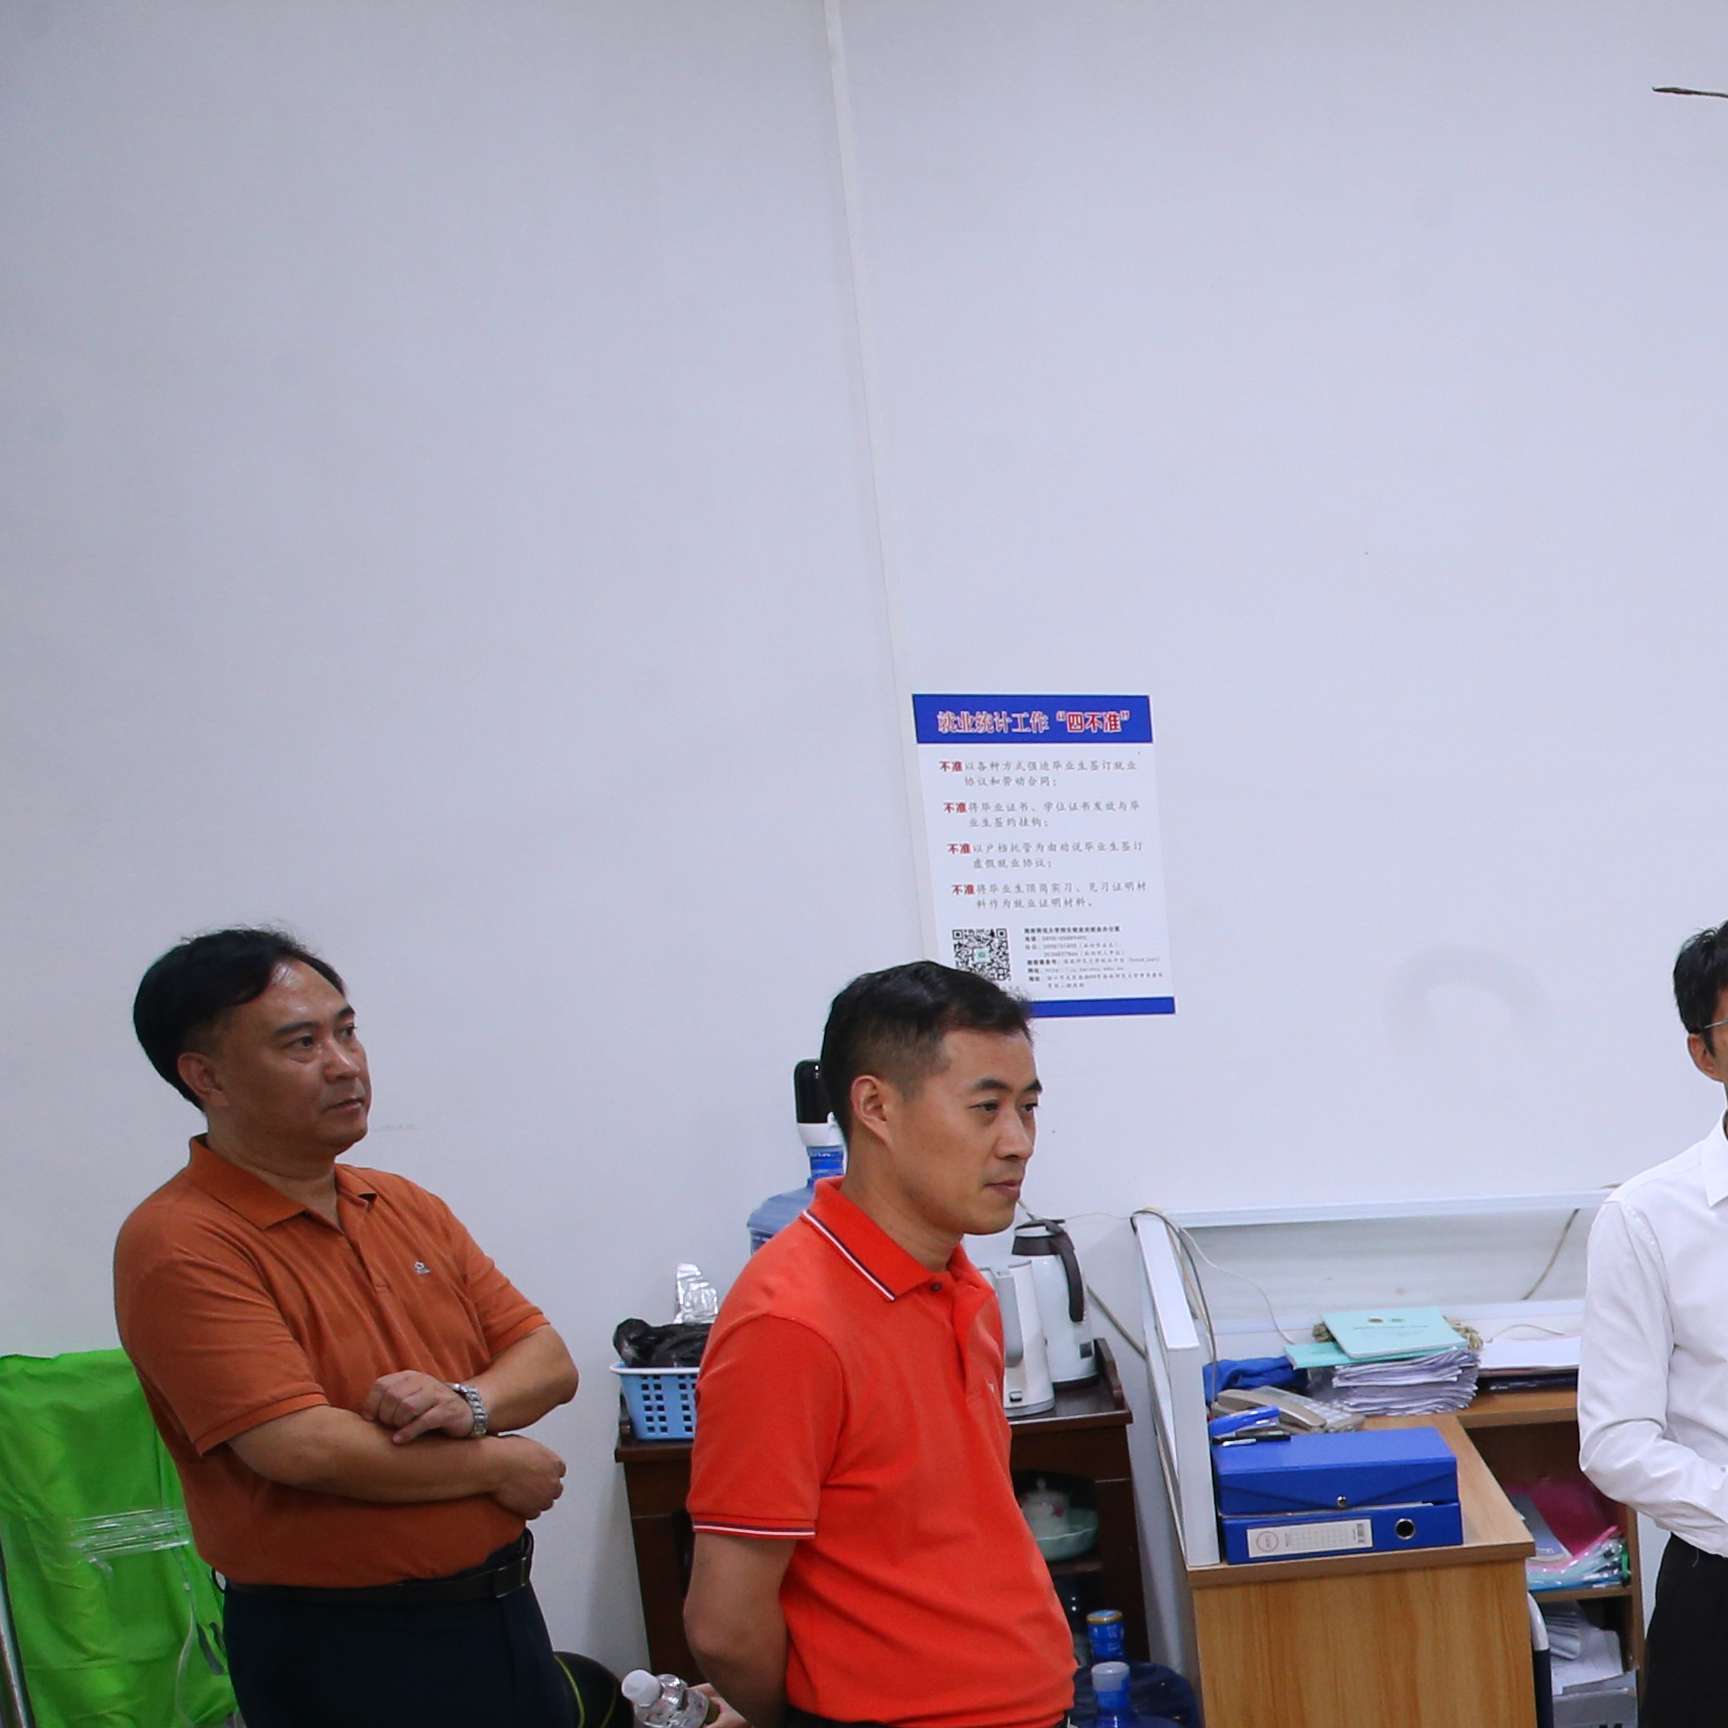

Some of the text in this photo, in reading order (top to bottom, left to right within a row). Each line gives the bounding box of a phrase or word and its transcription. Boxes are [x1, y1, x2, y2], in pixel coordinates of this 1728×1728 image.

[937, 710, 1130, 734] 就业统计工作“四不准”
